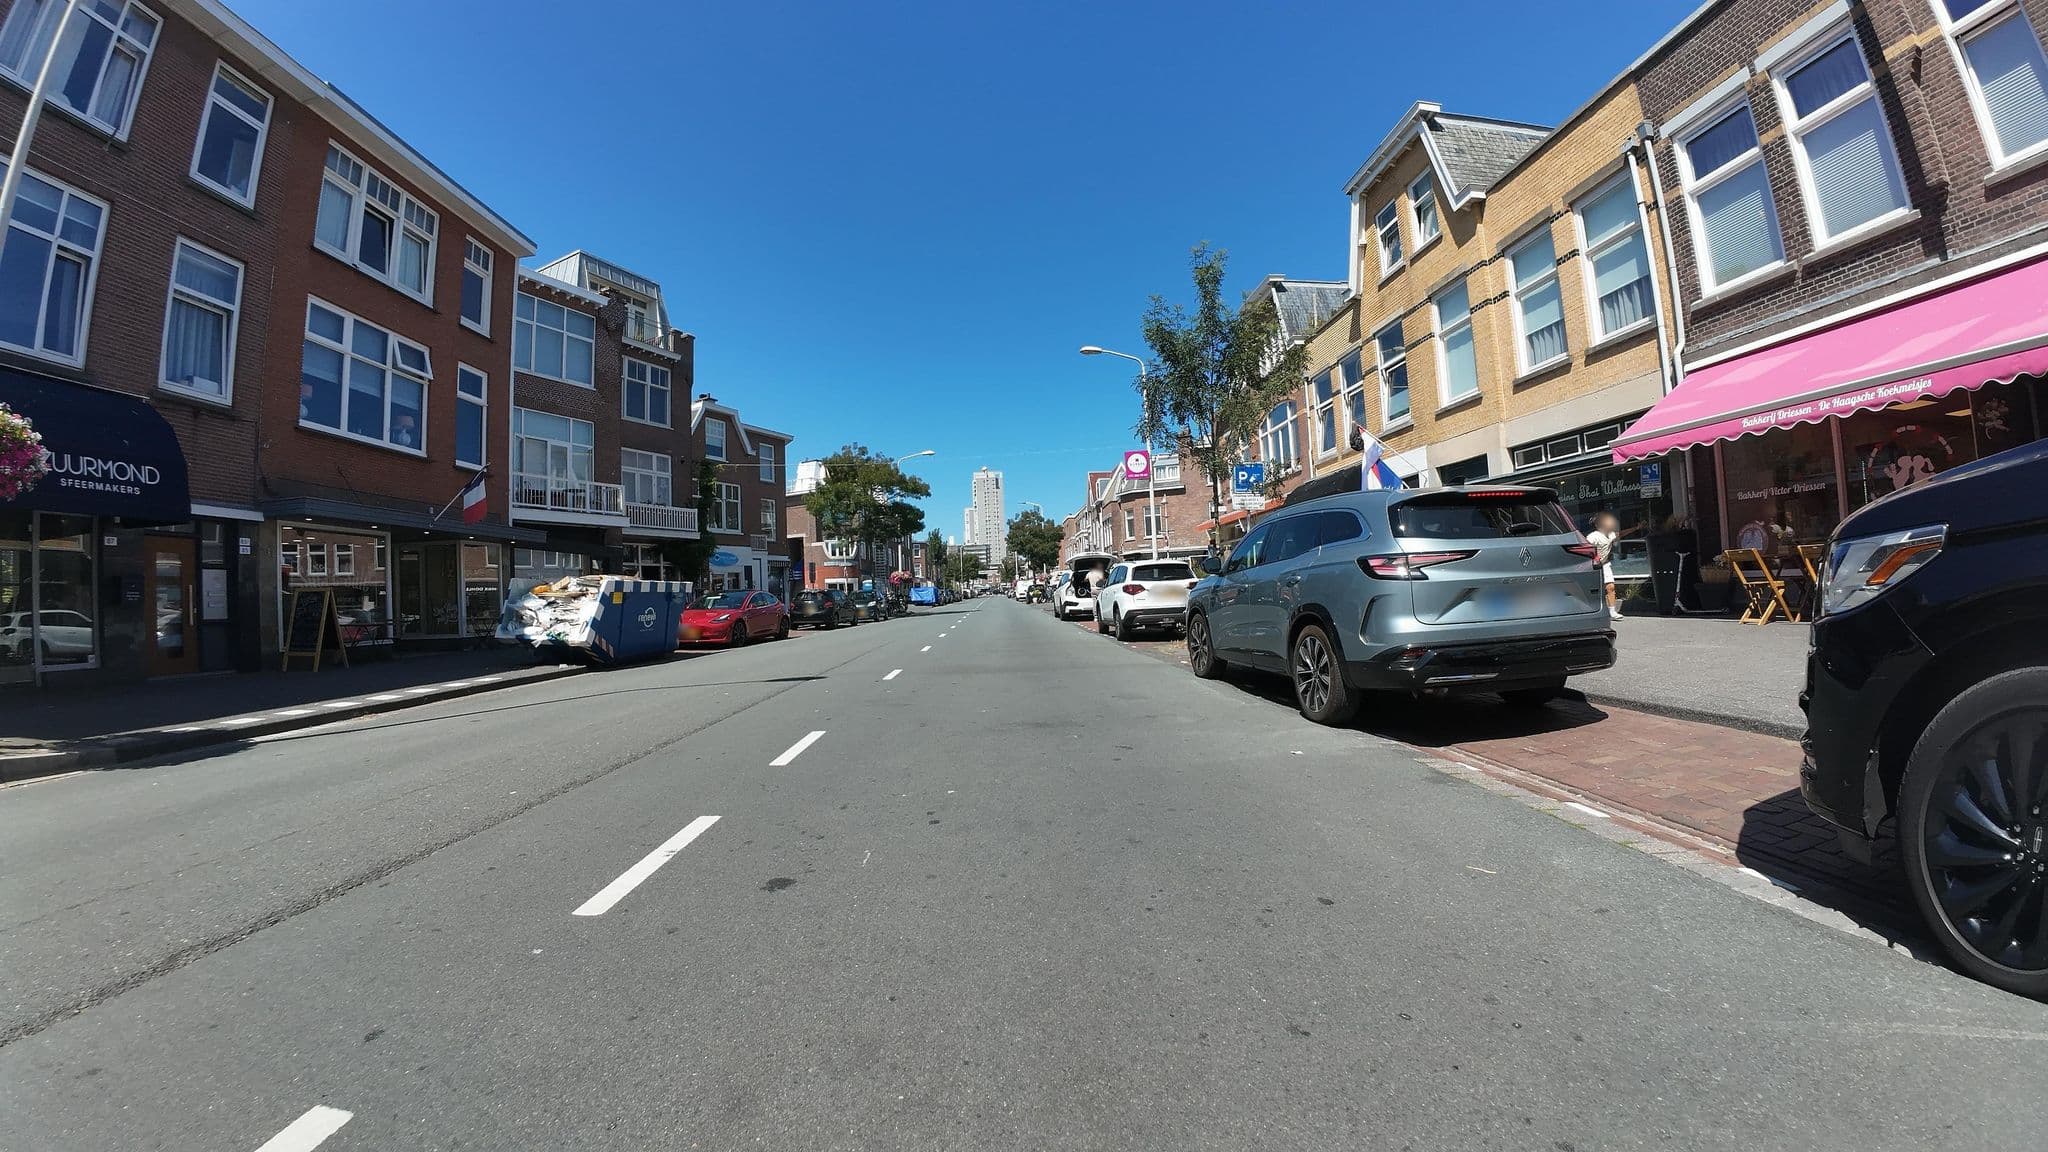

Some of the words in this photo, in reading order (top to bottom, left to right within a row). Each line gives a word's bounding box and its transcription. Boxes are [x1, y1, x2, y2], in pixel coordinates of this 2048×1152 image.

[1742, 412, 1776, 427] Bakkerij
[1777, 406, 1812, 420] Driessen
[1819, 400, 1830, 411] De
[1833, 392, 1876, 406] Haagsche
[1876, 379, 1932, 394] Koekmeisjes
[60, 478, 141, 495] SFEERMAKERS
[1238, 471, 1248, 485] P
[1578, 485, 1600, 499] Thai
[1600, 479, 1641, 495] Wellness
[1737, 488, 1768, 500] Bakkerij
[1792, 482, 1826, 493] Driessen
